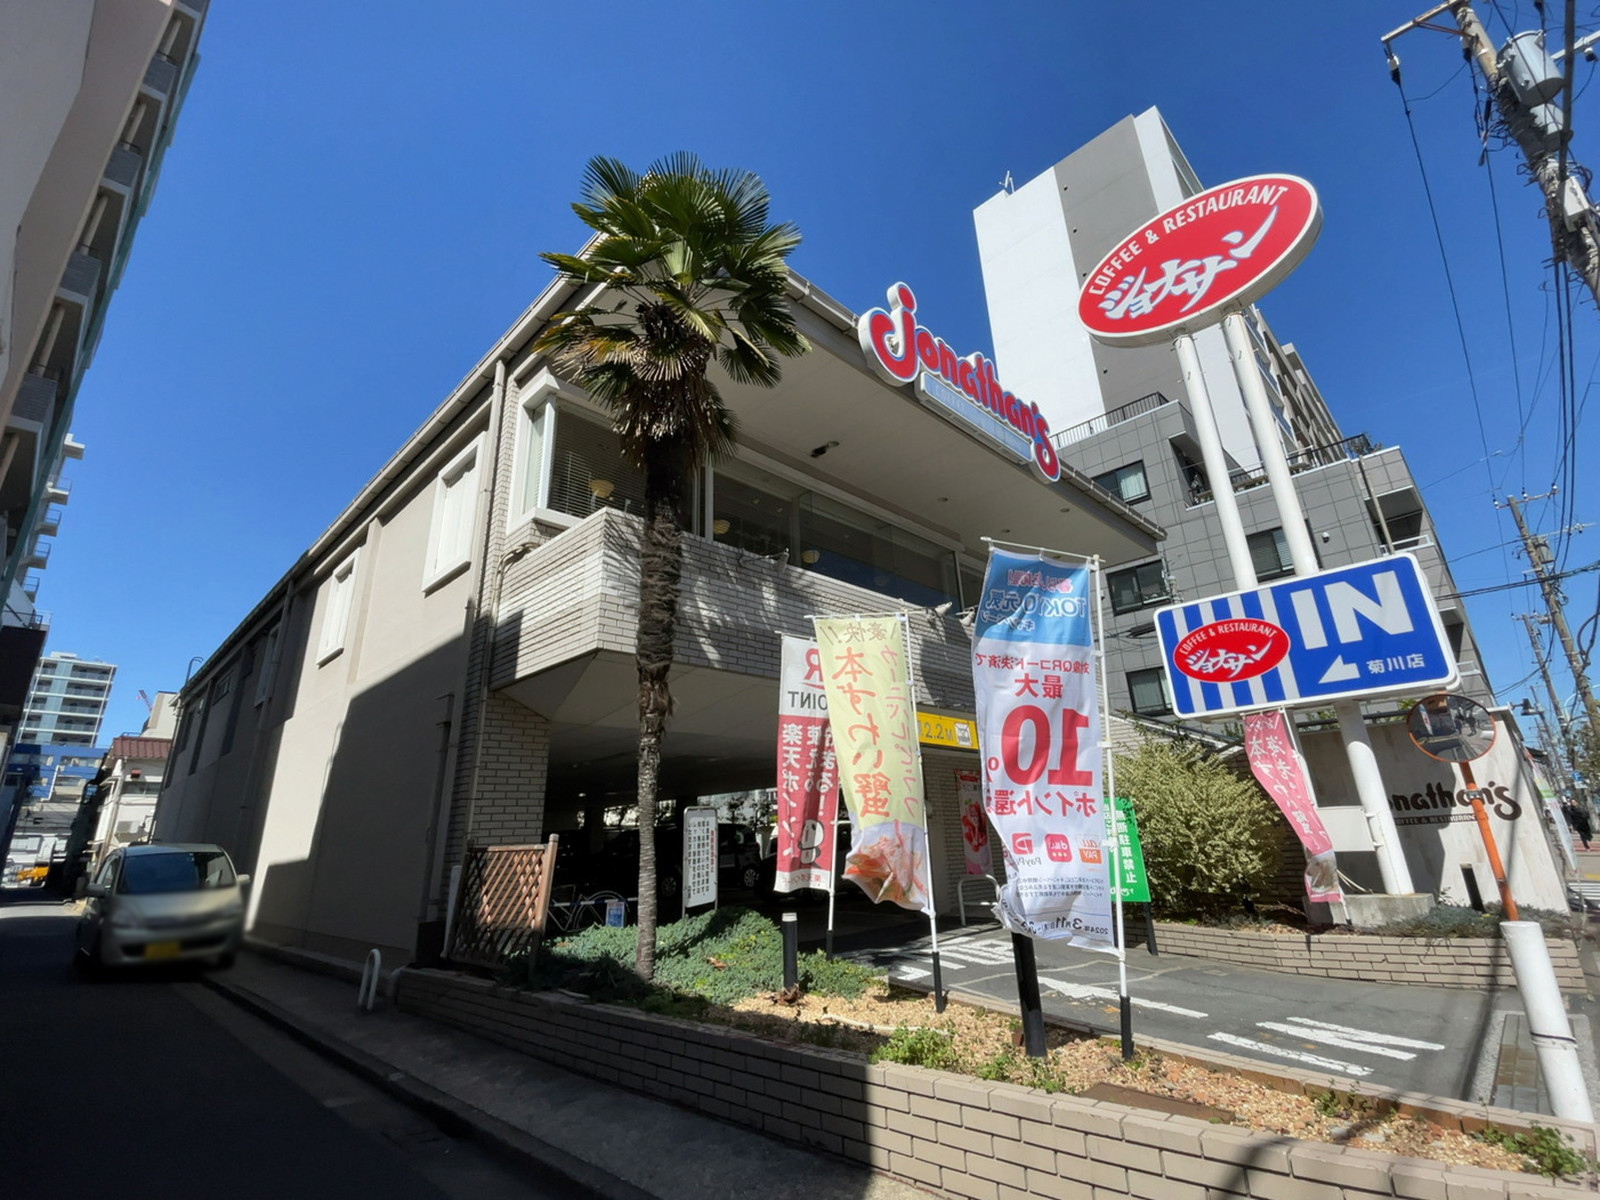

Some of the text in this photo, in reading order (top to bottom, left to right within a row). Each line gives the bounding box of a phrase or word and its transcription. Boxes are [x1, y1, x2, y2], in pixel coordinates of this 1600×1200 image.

[1088, 185, 1288, 295] COFFEE & RESTAURANT
[1098, 205, 1279, 320] ジョナサン
[1290, 570, 1415, 650] IN
[1179, 622, 1277, 655] COFFEE & RESTAURANT
[1185, 638, 1273, 679] ジョナサン
[1366, 653, 1425, 674] 菊川店
[1388, 781, 1522, 821] nathan's
